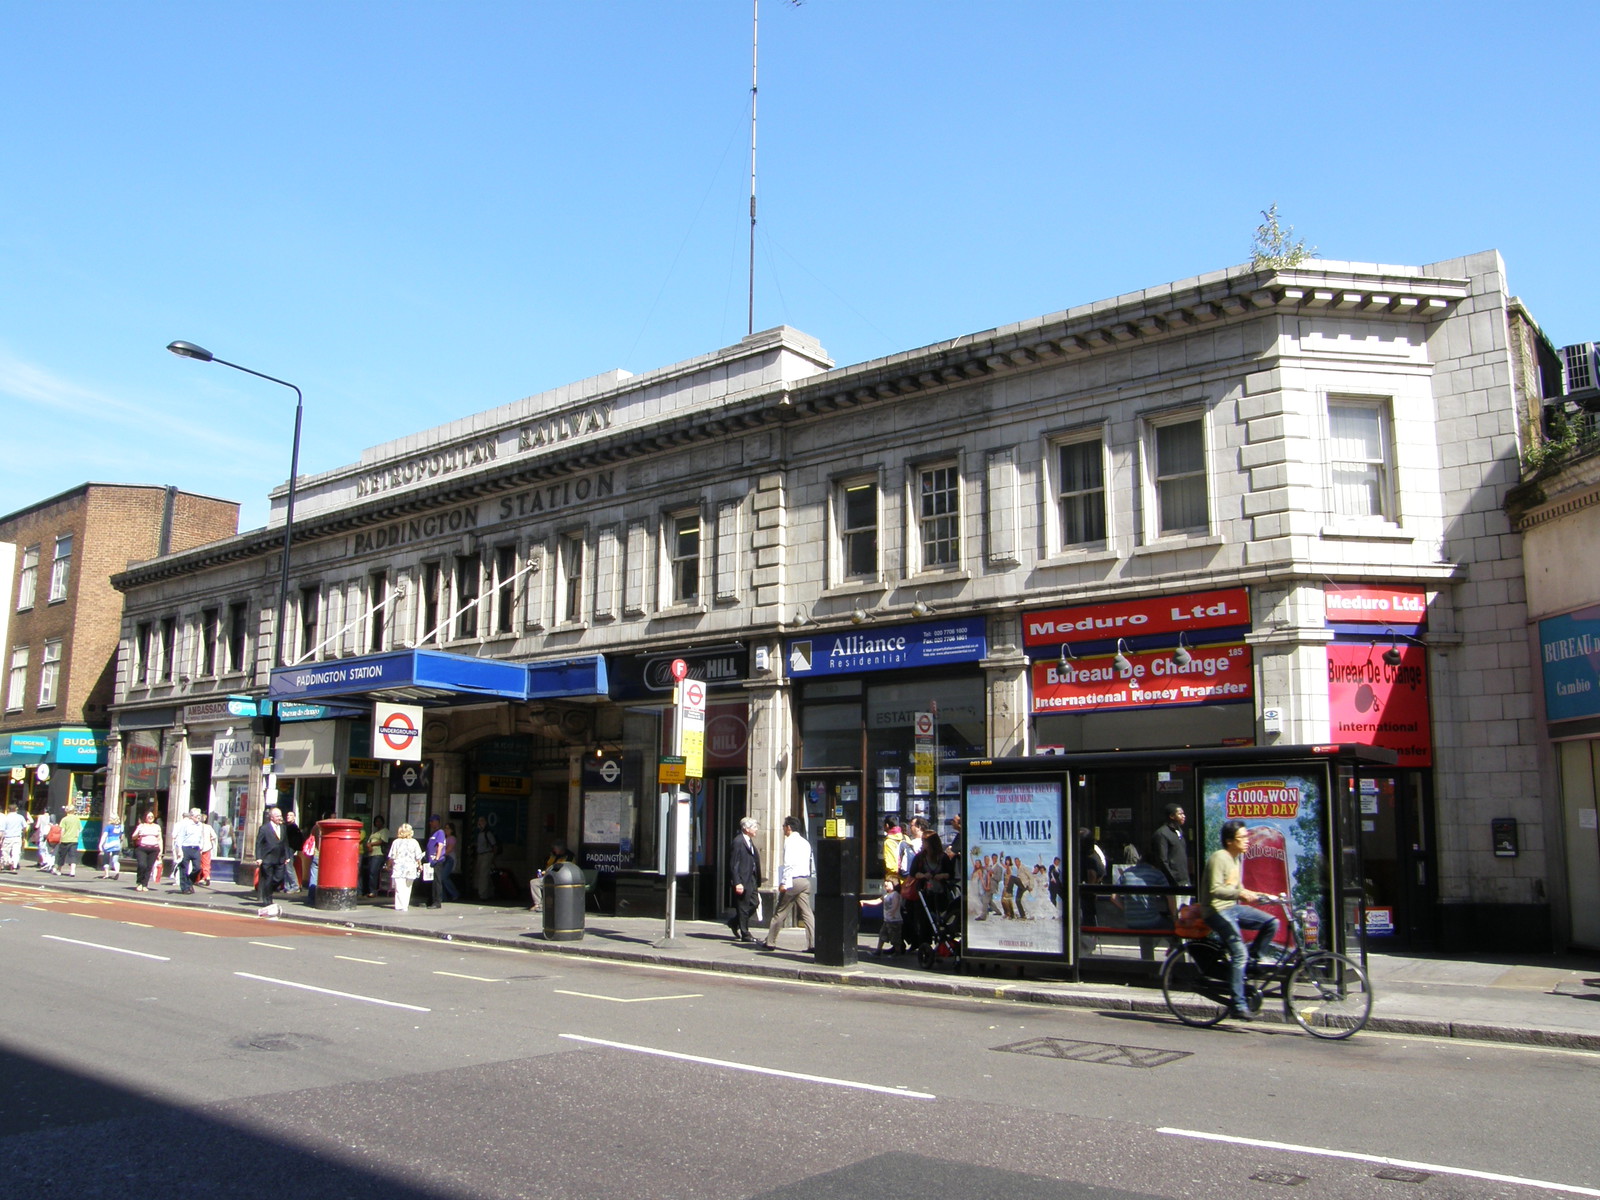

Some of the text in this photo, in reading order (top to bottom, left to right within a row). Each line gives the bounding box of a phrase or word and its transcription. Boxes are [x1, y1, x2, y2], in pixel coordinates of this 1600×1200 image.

[356, 402, 616, 498] METROPOLITAN RAILWAY
[353, 471, 615, 555] PADDINGTON STATION
[1327, 594, 1425, 611] Meduro Ltd.
[1030, 602, 1238, 636] Meduro Ltd.
[831, 635, 906, 657] Alliance
[1228, 648, 1244, 657] 185
[1544, 634, 1592, 662] BUREAU
[706, 658, 737, 678] HILL
[830, 652, 908, 668] Residential
[296, 665, 382, 688] PADDINGTON STATION
[676, 662, 684, 676] F
[1120, 662, 1146, 678] De
[1328, 658, 1422, 692] Bureau De Change
[1128, 678, 1140, 688] &
[1556, 678, 1591, 696] Cambio
[1036, 682, 1248, 708] International Money Transfer
[188, 703, 228, 716] AMBASSADO
[876, 710, 916, 724] ESTAT
[379, 727, 418, 736] UNDERGROUND
[1338, 720, 1418, 732] International
[63, 738, 109, 746] BUDGEN
[218, 740, 251, 758] REGENT
[712, 735, 736, 750] HILL
[1228, 790, 1263, 803] £1000
[1268, 789, 1297, 803] WON
[1229, 804, 1296, 815] EVERY DAY
[979, 820, 1051, 840] MAMMA MIA!
[586, 853, 630, 863] PADDINGTON
[1244, 845, 1285, 860] Ribena
[594, 864, 620, 873] STATION
